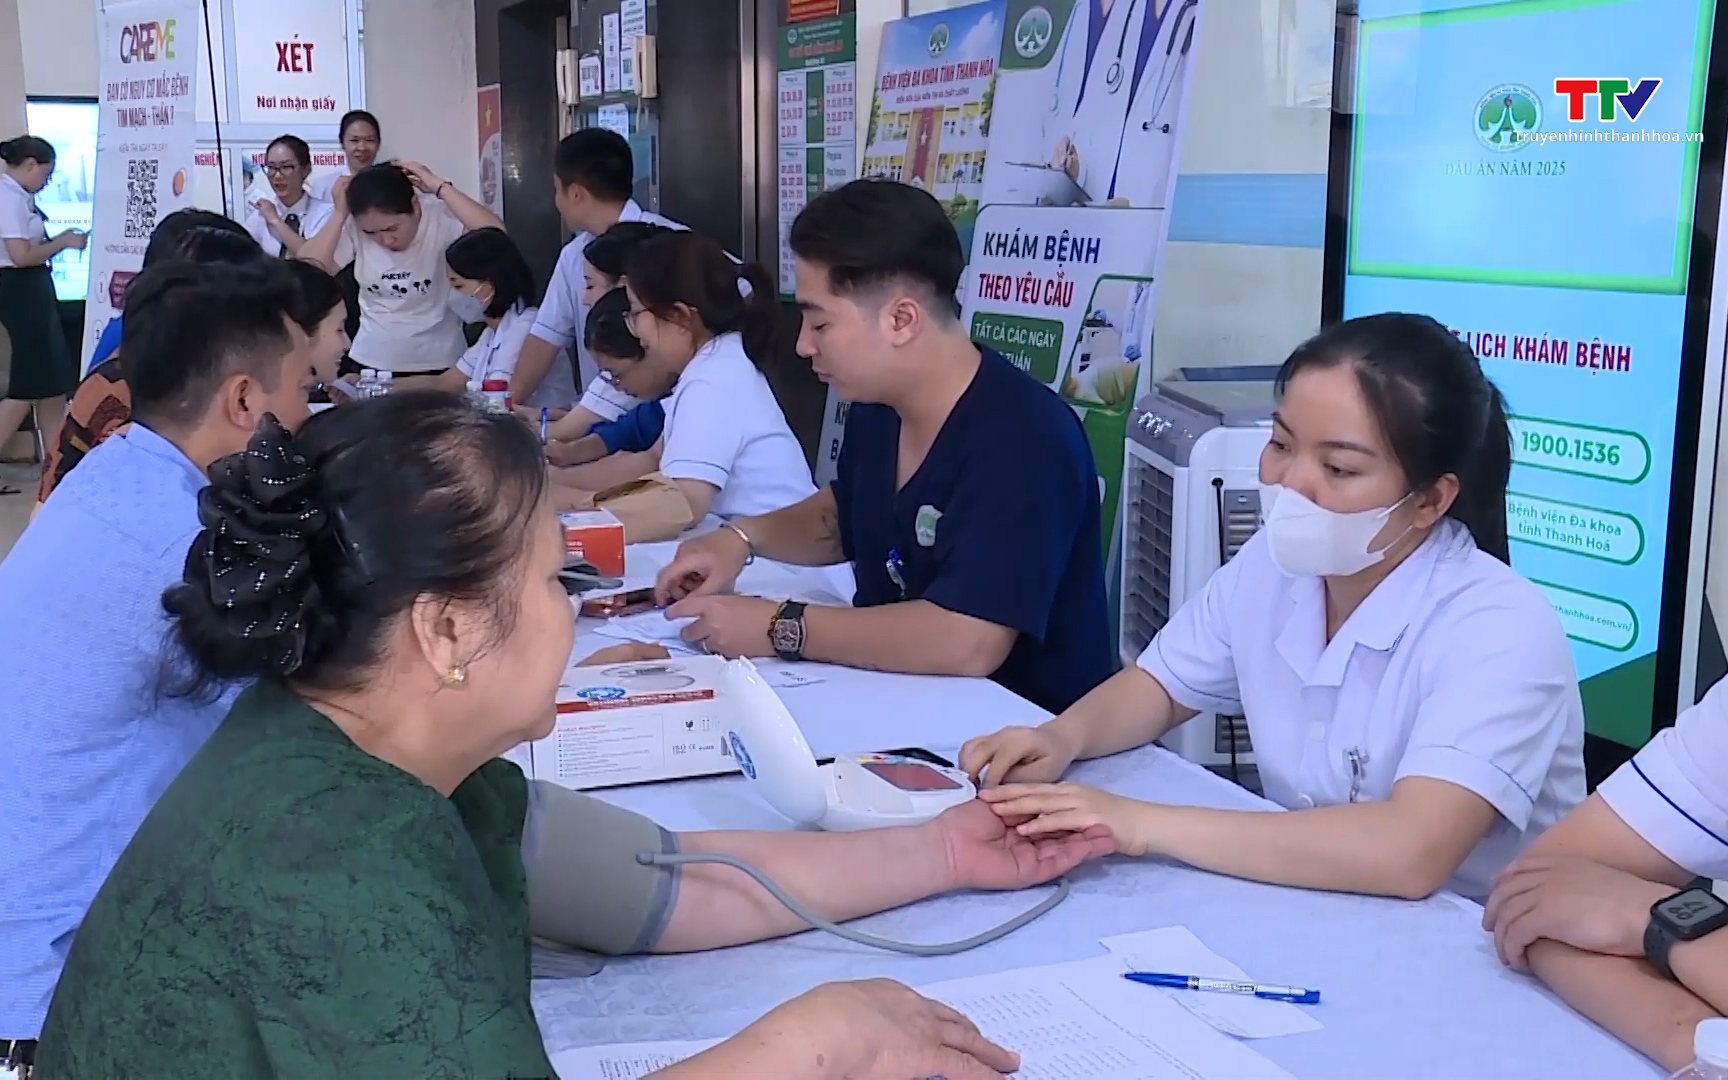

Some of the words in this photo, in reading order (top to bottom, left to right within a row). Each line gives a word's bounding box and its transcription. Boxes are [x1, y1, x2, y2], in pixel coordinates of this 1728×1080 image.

[275, 34, 314, 72] XÉT
[881, 72, 897, 93] BỆNH
[921, 68, 939, 86] KHOA
[956, 62, 980, 80] THANH
[257, 95, 276, 108] Nơi
[280, 96, 308, 111] nhận
[312, 94, 336, 111] giấy
[313, 152, 345, 167] NGHIỆM
[1536, 161, 1566, 176] 2025
[983, 228, 1039, 260] KHÁM
[1043, 229, 1101, 268] BỆNH
[978, 273, 1012, 301] THEO
[1015, 271, 1042, 305] YÊU
[975, 320, 992, 339] TẤT
[992, 321, 1006, 342] CẢ
[1007, 325, 1028, 345] CÁC
[1028, 329, 1057, 349] NGÀY
[1513, 332, 1569, 366] KHÁM
[1575, 338, 1632, 375] BỆNH
[1522, 431, 1621, 466] 1900.1536
[1508, 502, 1537, 518] Bệnh
[1541, 509, 1566, 525] viện
[1570, 515, 1586, 528] Đa
[1590, 518, 1622, 536] khoa
[1518, 519, 1542, 537] tỉnh
[1545, 527, 1583, 546] Thanh
